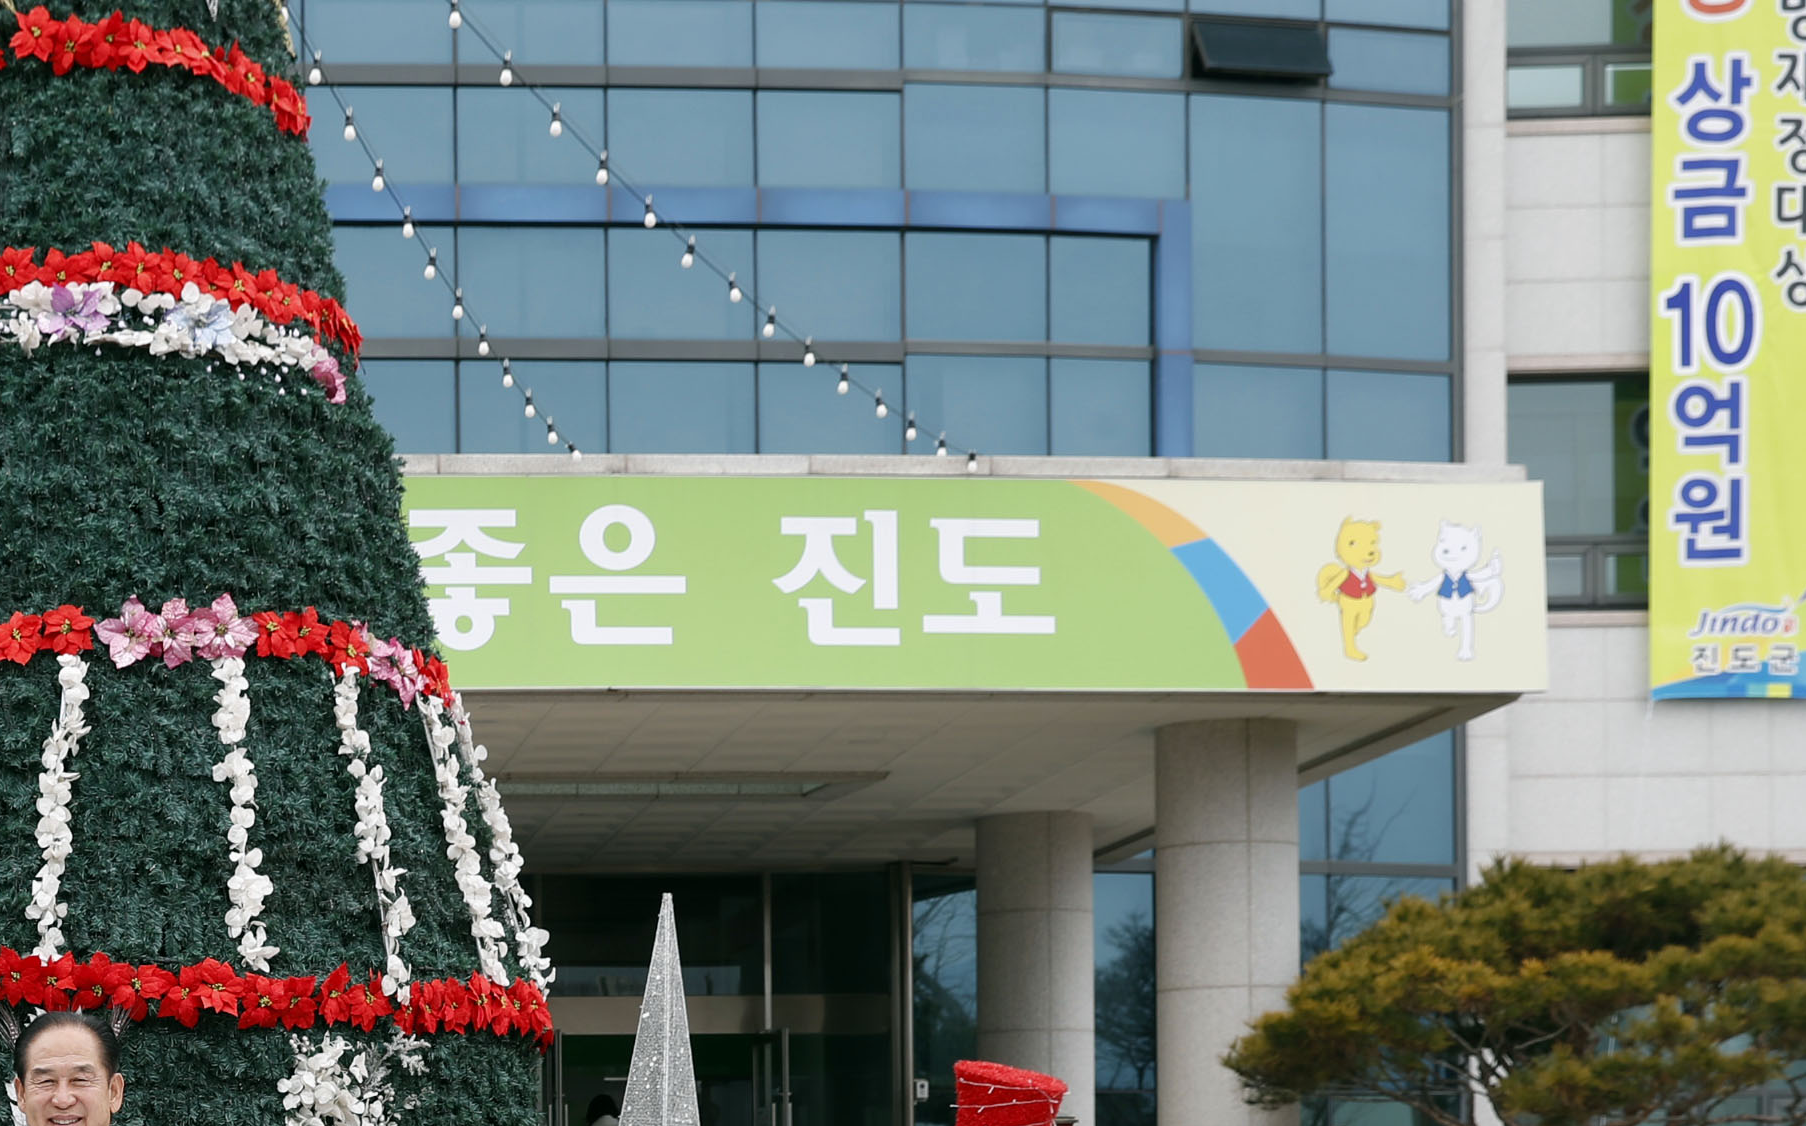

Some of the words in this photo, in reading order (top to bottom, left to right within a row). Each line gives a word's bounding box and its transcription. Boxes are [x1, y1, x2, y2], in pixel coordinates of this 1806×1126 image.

[1674, 58, 1753, 239] 상금
[407, 503, 688, 651] 좋은
[771, 508, 1057, 647] 진도
[1689, 611, 1780, 637] Jindo
